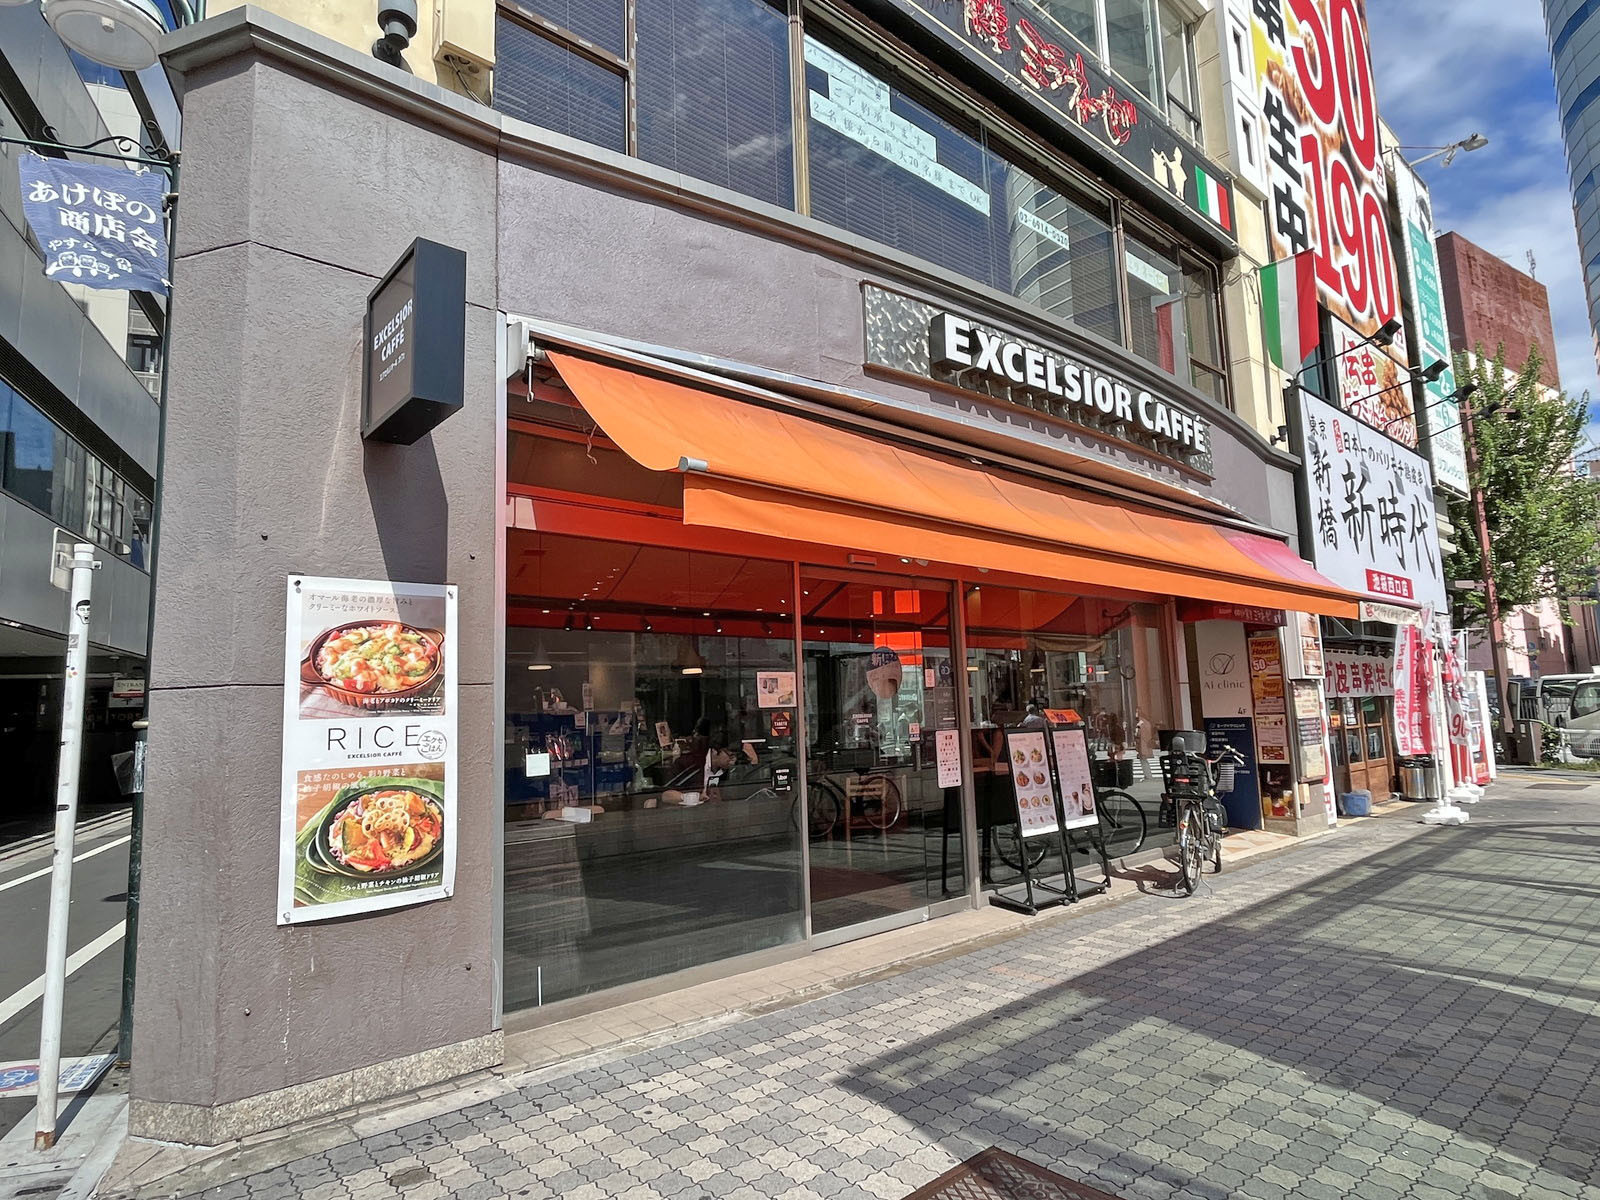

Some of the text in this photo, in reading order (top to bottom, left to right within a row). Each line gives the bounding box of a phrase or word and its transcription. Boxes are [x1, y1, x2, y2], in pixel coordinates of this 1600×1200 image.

[1262, 86, 1310, 256] 生中
[28, 180, 157, 224] あけぼの
[57, 206, 158, 258] 商店会
[1300, 134, 1396, 327] 190
[373, 298, 413, 351] EXCELSIOR
[944, 313, 1133, 422] EXCELSIOR
[1340, 458, 1437, 581] 新時代
[1217, 680, 1246, 690] clinic
[1252, 659, 1267, 671] 50
[327, 725, 421, 751] RICE
